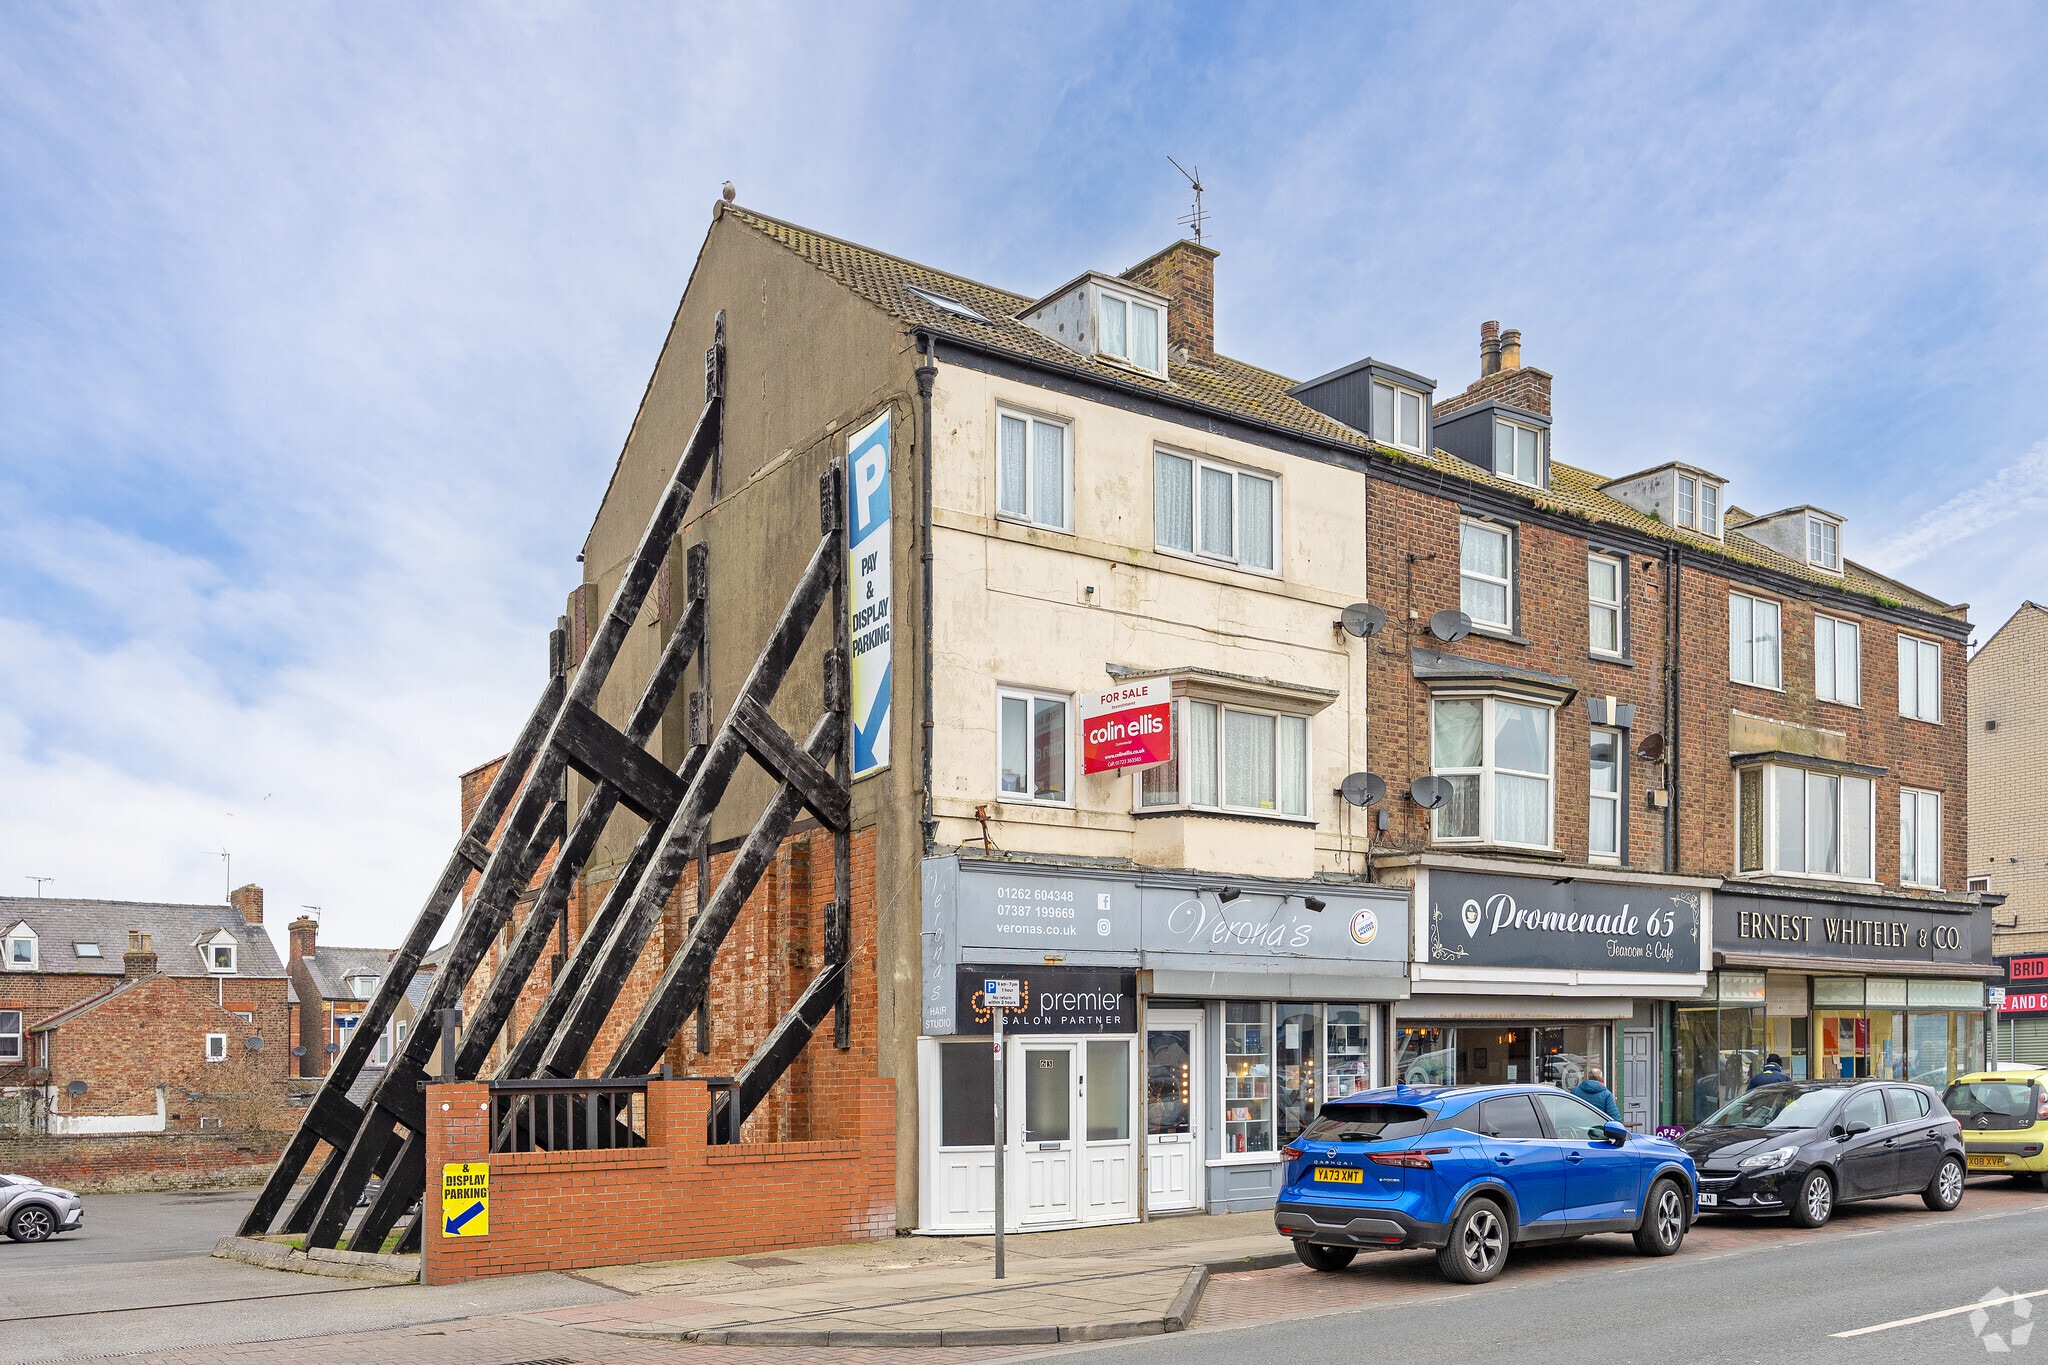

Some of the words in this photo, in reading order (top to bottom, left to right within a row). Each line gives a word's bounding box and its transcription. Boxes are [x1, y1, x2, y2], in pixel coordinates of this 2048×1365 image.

[855, 443, 886, 531] P
[862, 551, 878, 577] PAY
[866, 580, 874, 599] &
[852, 597, 889, 633] DISPLAY
[853, 623, 890, 658] PARKING
[1101, 692, 1119, 705] FOR
[1122, 686, 1148, 700] SALE
[1089, 721, 1125, 744] colin
[1127, 714, 1163, 736] ellis
[997, 887, 1031, 900] 01262
[1034, 889, 1074, 902] 604348
[997, 904, 1031, 917] 07387
[1035, 906, 1075, 919] 199669
[1485, 893, 1640, 937] Promenade
[1646, 908, 1675, 938] 65
[996, 923, 1077, 936] veronas.co.uk
[1168, 899, 1312, 947] Verona's
[1740, 911, 1813, 942] ERNEST
[1826, 917, 1910, 947] WHITELEY
[1919, 928, 1927, 948] &
[1936, 925, 1962, 950] CO.
[1606, 939, 1643, 957] Tearoom
[1645, 943, 1652, 958] &
[1654, 941, 1674, 963] Cafe
[2014, 961, 2044, 976] BRID
[1040, 987, 1124, 1016] premier
[2011, 995, 2036, 1010] AND
[930, 1007, 947, 1016] HAIR
[1002, 1016, 1051, 1025] SALON
[1061, 1015, 1121, 1025] PARTNER
[925, 1018, 951, 1029] STUDIO
[462, 1163, 470, 1173] &
[1318, 1169, 1340, 1181] YA73
[1341, 1170, 1359, 1182] XMT
[446, 1174, 486, 1186] DISPLAY
[444, 1187, 487, 1200] PARKING
